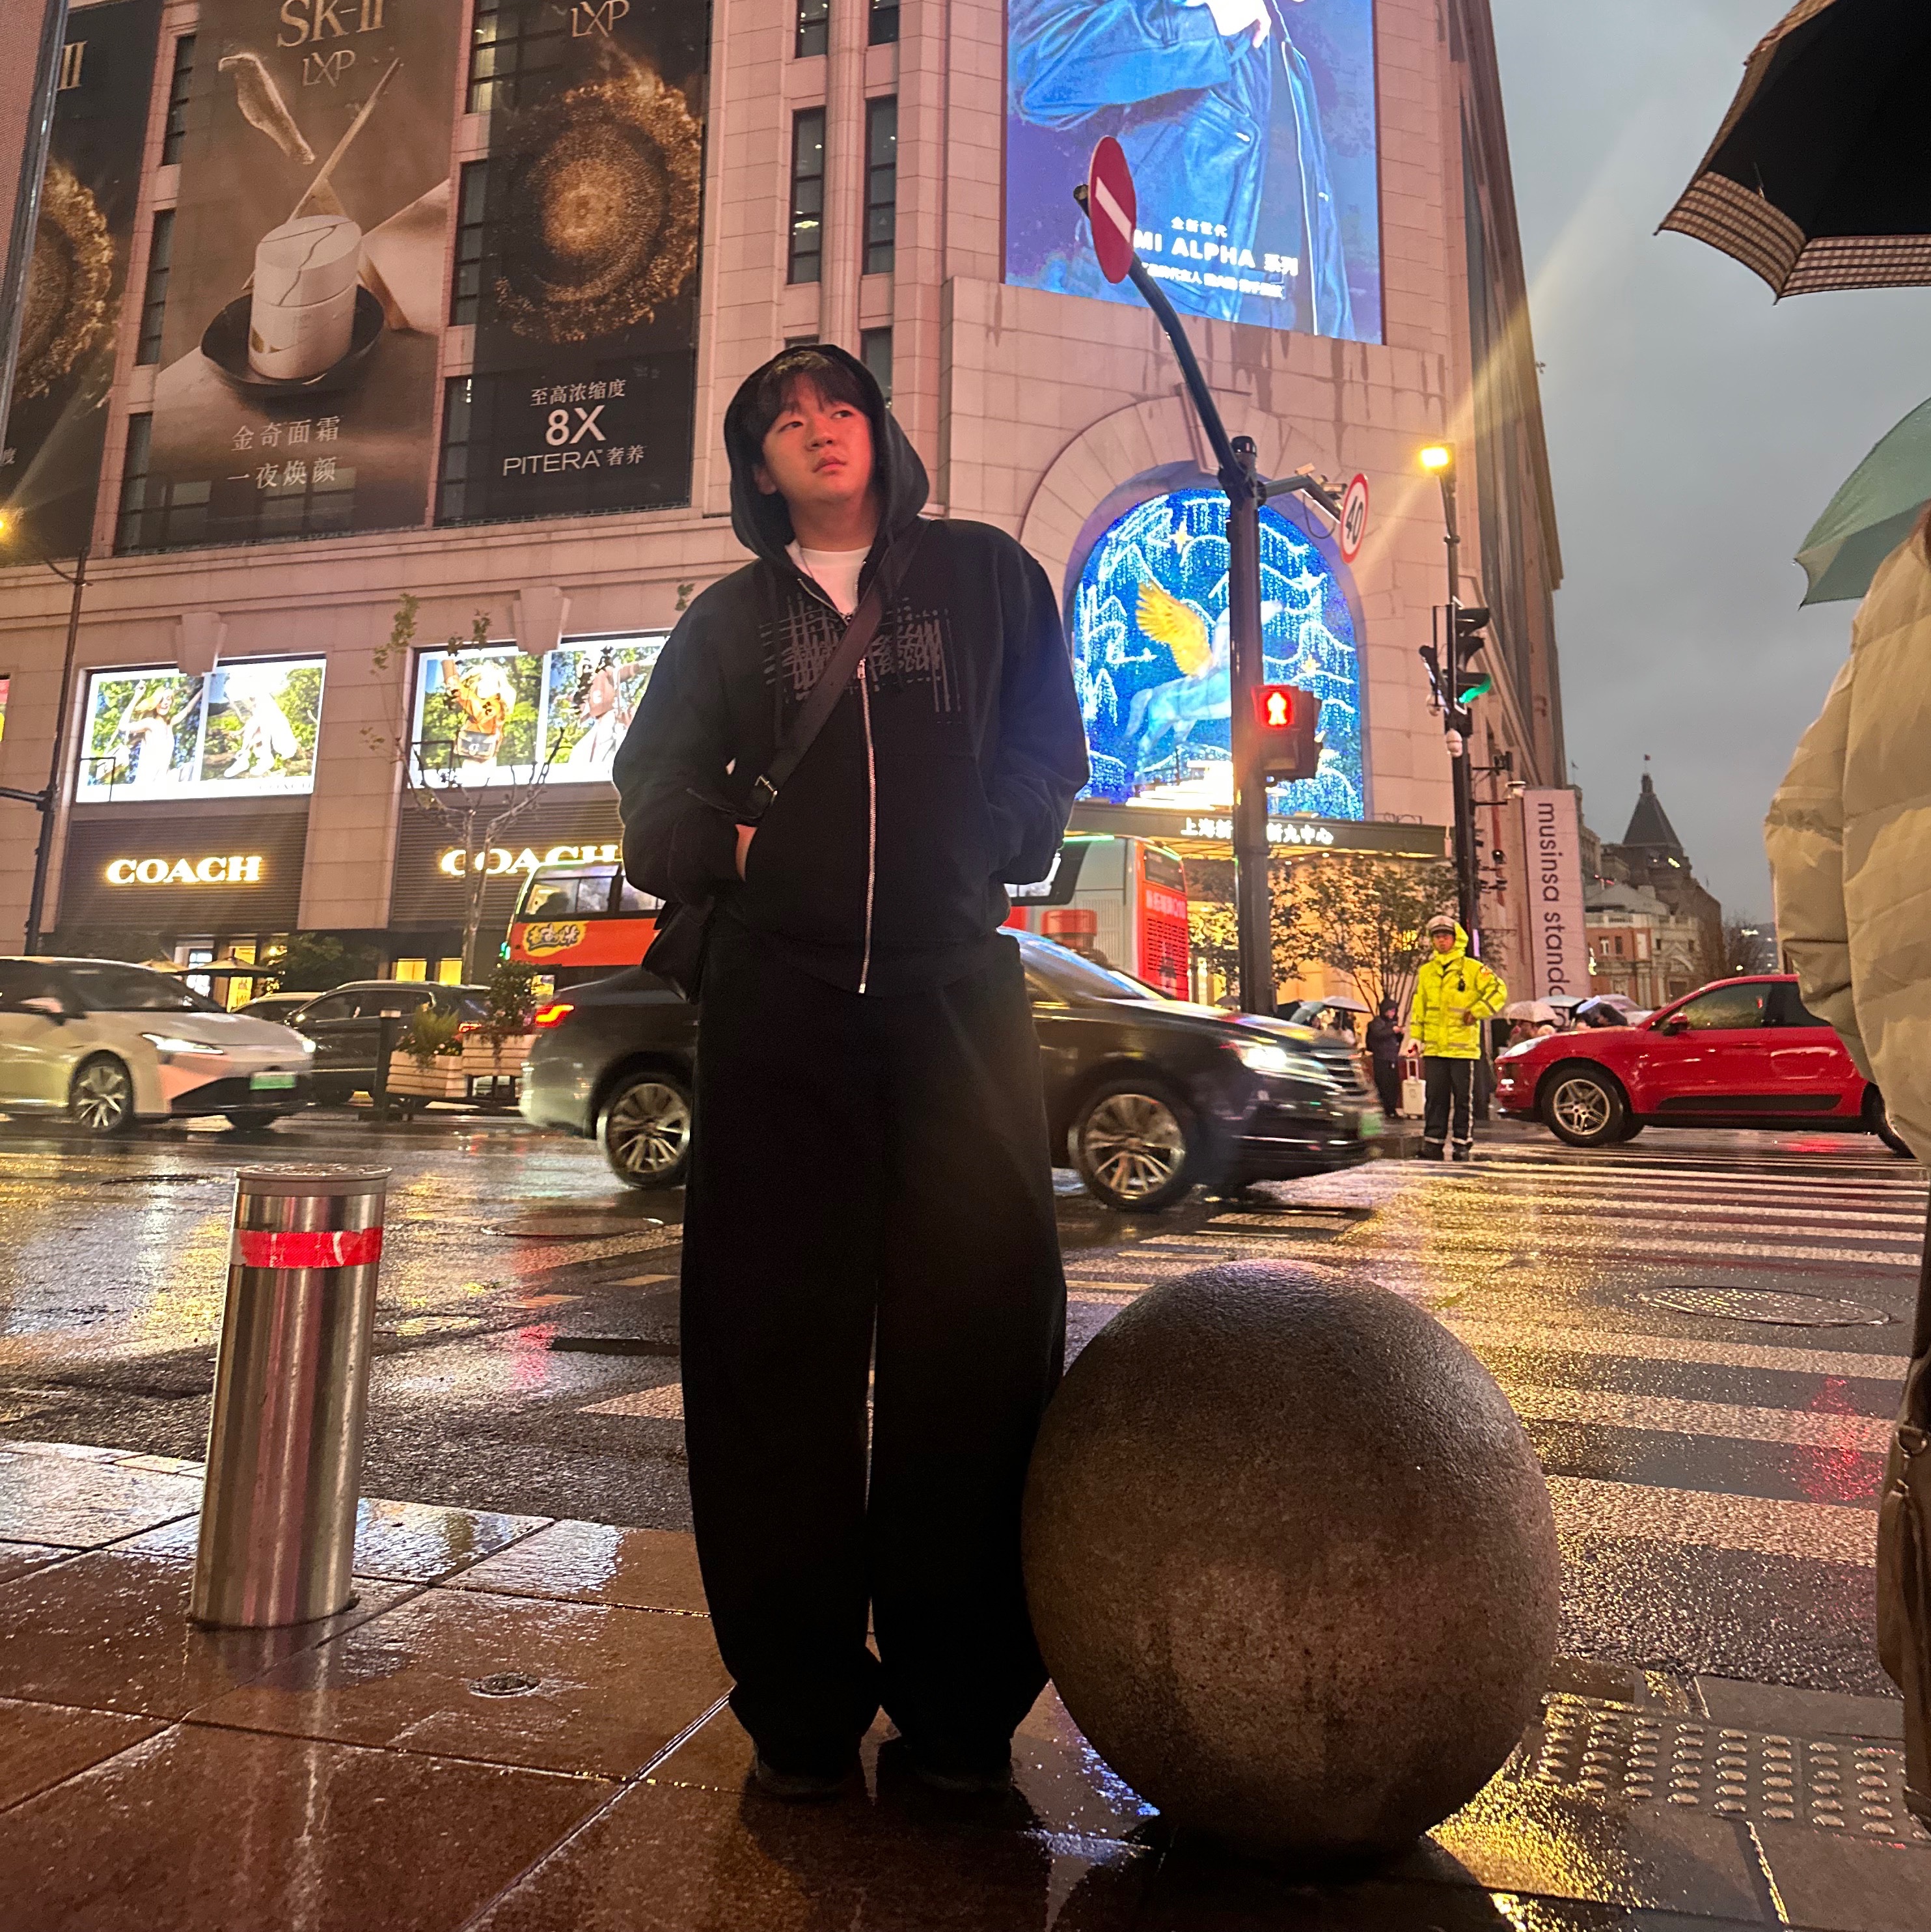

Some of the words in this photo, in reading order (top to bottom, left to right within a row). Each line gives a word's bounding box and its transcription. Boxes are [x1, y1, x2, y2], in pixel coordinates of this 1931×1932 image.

[277, 0, 387, 48] SK-II
[571, 0, 629, 37] LXP
[302, 50, 356, 87] LXP
[1171, 237, 1256, 269] ALPHA
[530, 379, 627, 406] 至高浓缩度
[230, 415, 340, 451] 金奇面霜
[545, 405, 607, 446] 8X
[227, 456, 337, 489] 一夜焕颜
[607, 445, 644, 467] 奢养
[1345, 495, 1363, 545] 40
[107, 856, 262, 884] COACH
[441, 845, 618, 876] COACH
[1538, 803, 1563, 902] musinsa
